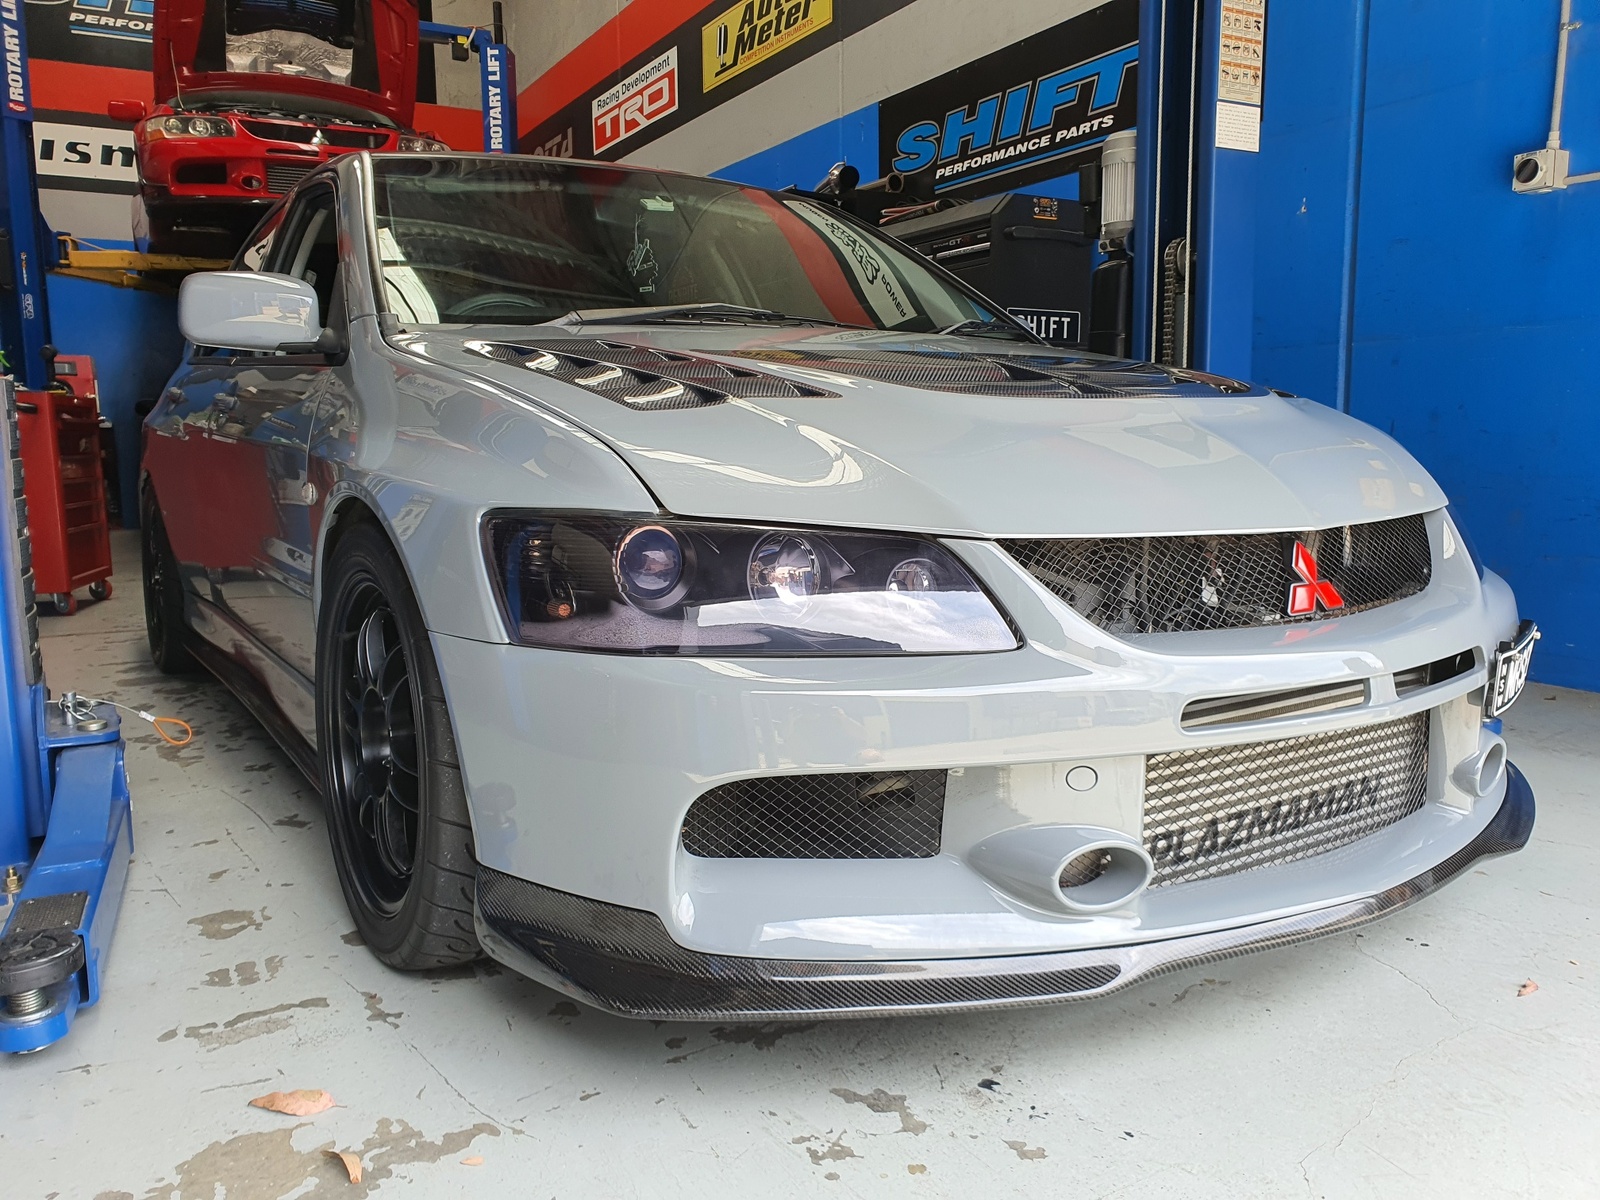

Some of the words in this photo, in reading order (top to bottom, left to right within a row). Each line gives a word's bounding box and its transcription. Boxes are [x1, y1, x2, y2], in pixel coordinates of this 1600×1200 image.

[0, 0, 17, 21] LI
[733, 0, 817, 66] Meter
[739, 41, 775, 65] COMPETITION
[775, 17, 814, 46] INSTRUMENTS
[3, 23, 25, 102] ROTARY
[487, 47, 500, 82] LIFT
[597, 90, 620, 111] Racing
[621, 55, 670, 95] Development
[489, 84, 503, 150] ROTARY
[597, 77, 670, 139] TRD
[892, 40, 1139, 175] SHIFT
[935, 135, 1052, 179] PERFORMANCE
[1055, 115, 1114, 143] PARTS
[1016, 315, 1071, 339] HIFT
